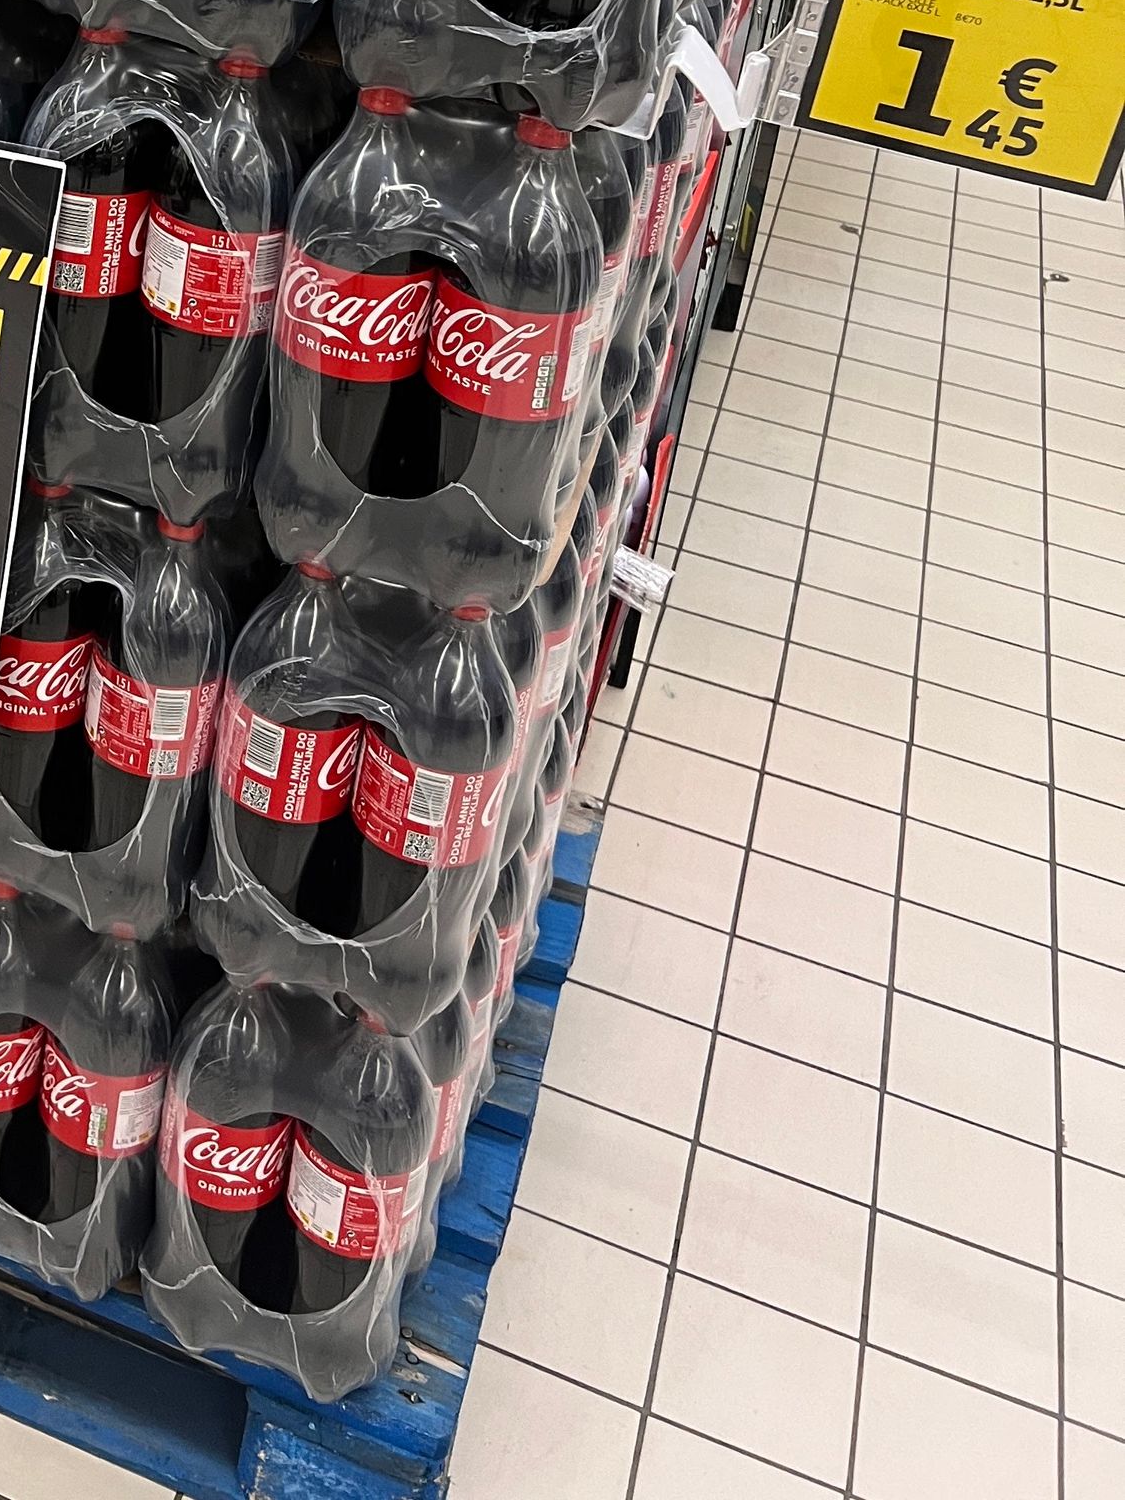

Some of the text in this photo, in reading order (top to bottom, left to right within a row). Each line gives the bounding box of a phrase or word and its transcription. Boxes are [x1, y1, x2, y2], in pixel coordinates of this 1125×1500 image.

[955, 12, 983, 26] 8€70
[874, 28, 1058, 137] 1 €
[965, 109, 1045, 157] 45
[99, 198, 119, 294] ODDAJ MNIE DO
[112, 198, 127, 267] RECYKLINGU
[297, 333, 417, 363] ORIGINAL TASTE
[446, 367, 492, 396] TASTE
[52, 699, 85, 713] TAST
[283, 732, 308, 820] ODDAJ MNIE DO
[297, 733, 317, 796] RECYKLINGU
[449, 775, 475, 865] ODDAJ MNIE DO
[198, 1180, 264, 1197] ORIGINAL
